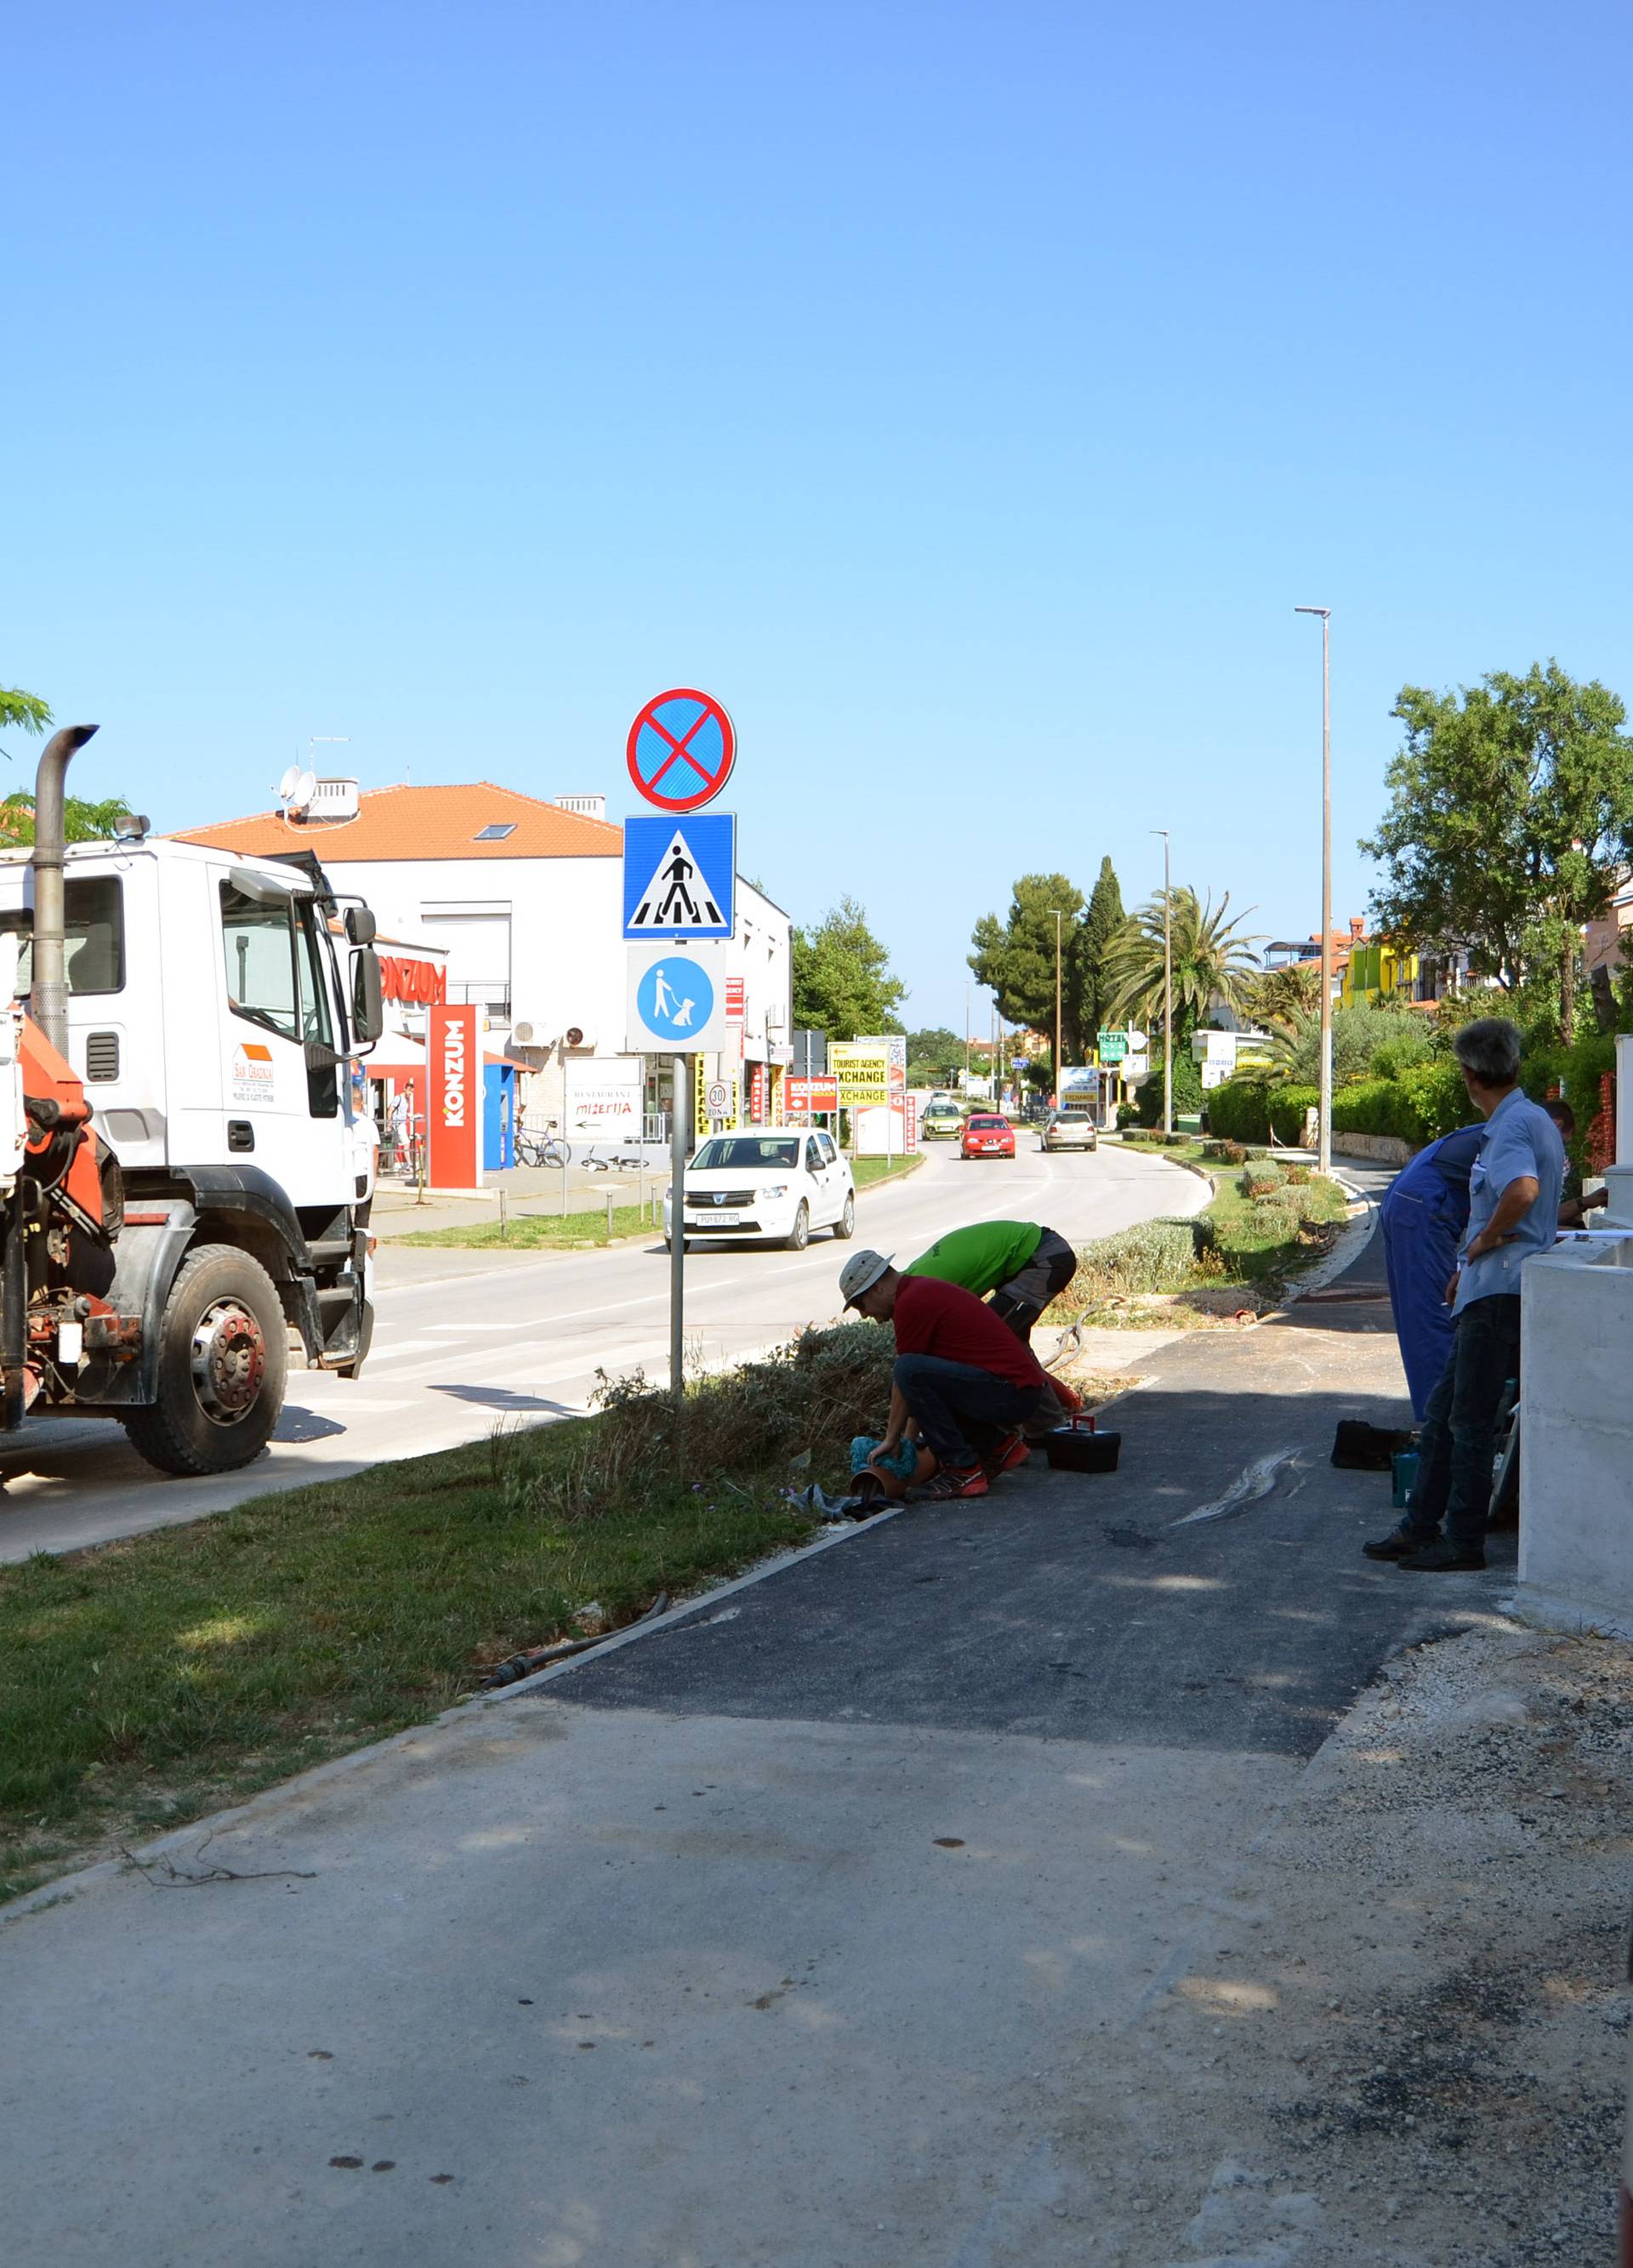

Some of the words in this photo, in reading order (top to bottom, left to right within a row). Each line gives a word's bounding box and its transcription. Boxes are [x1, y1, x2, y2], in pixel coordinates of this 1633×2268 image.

[378, 956, 447, 1006] ONZUM
[834, 1059, 858, 1068] TOURIST
[861, 1059, 885, 1068] AGENCY
[444, 1020, 464, 1126] KONZUM
[834, 1071, 885, 1083] XCHANGE
[712, 1089, 723, 1103] 30
